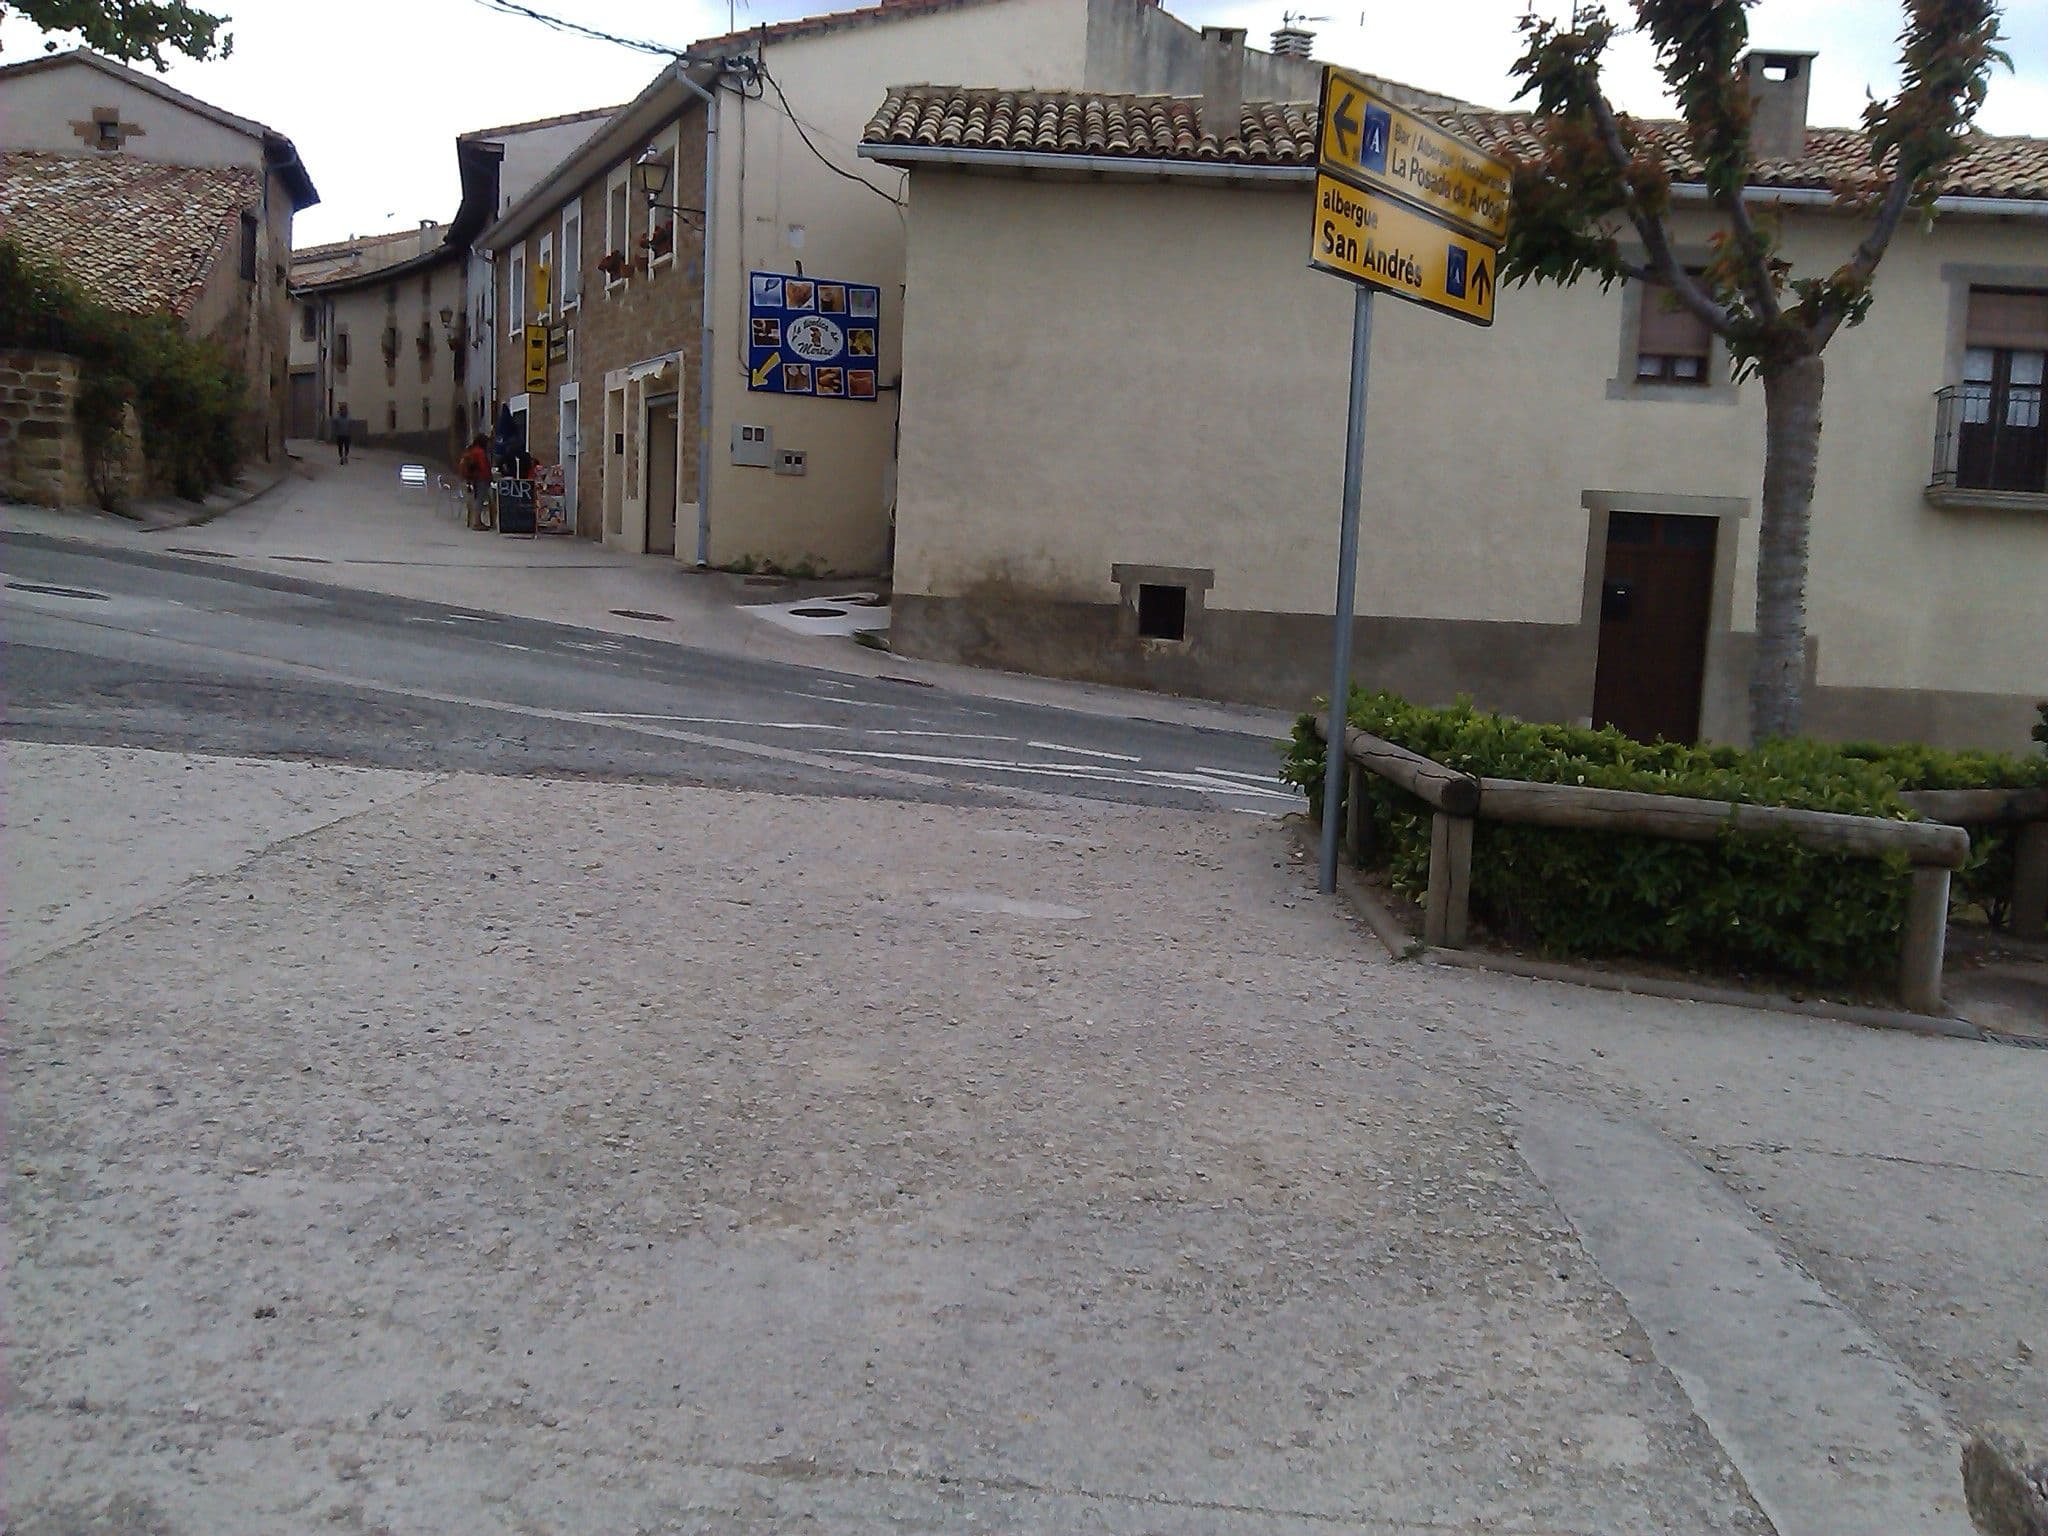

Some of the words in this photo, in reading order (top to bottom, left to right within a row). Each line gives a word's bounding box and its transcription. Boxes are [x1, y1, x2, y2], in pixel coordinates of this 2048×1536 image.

[1391, 147, 1407, 178] La
[1323, 188, 1378, 230] albergue
[1322, 220, 1358, 264] San
[1362, 236, 1423, 288] Andrés
[499, 479, 532, 500] BAR
